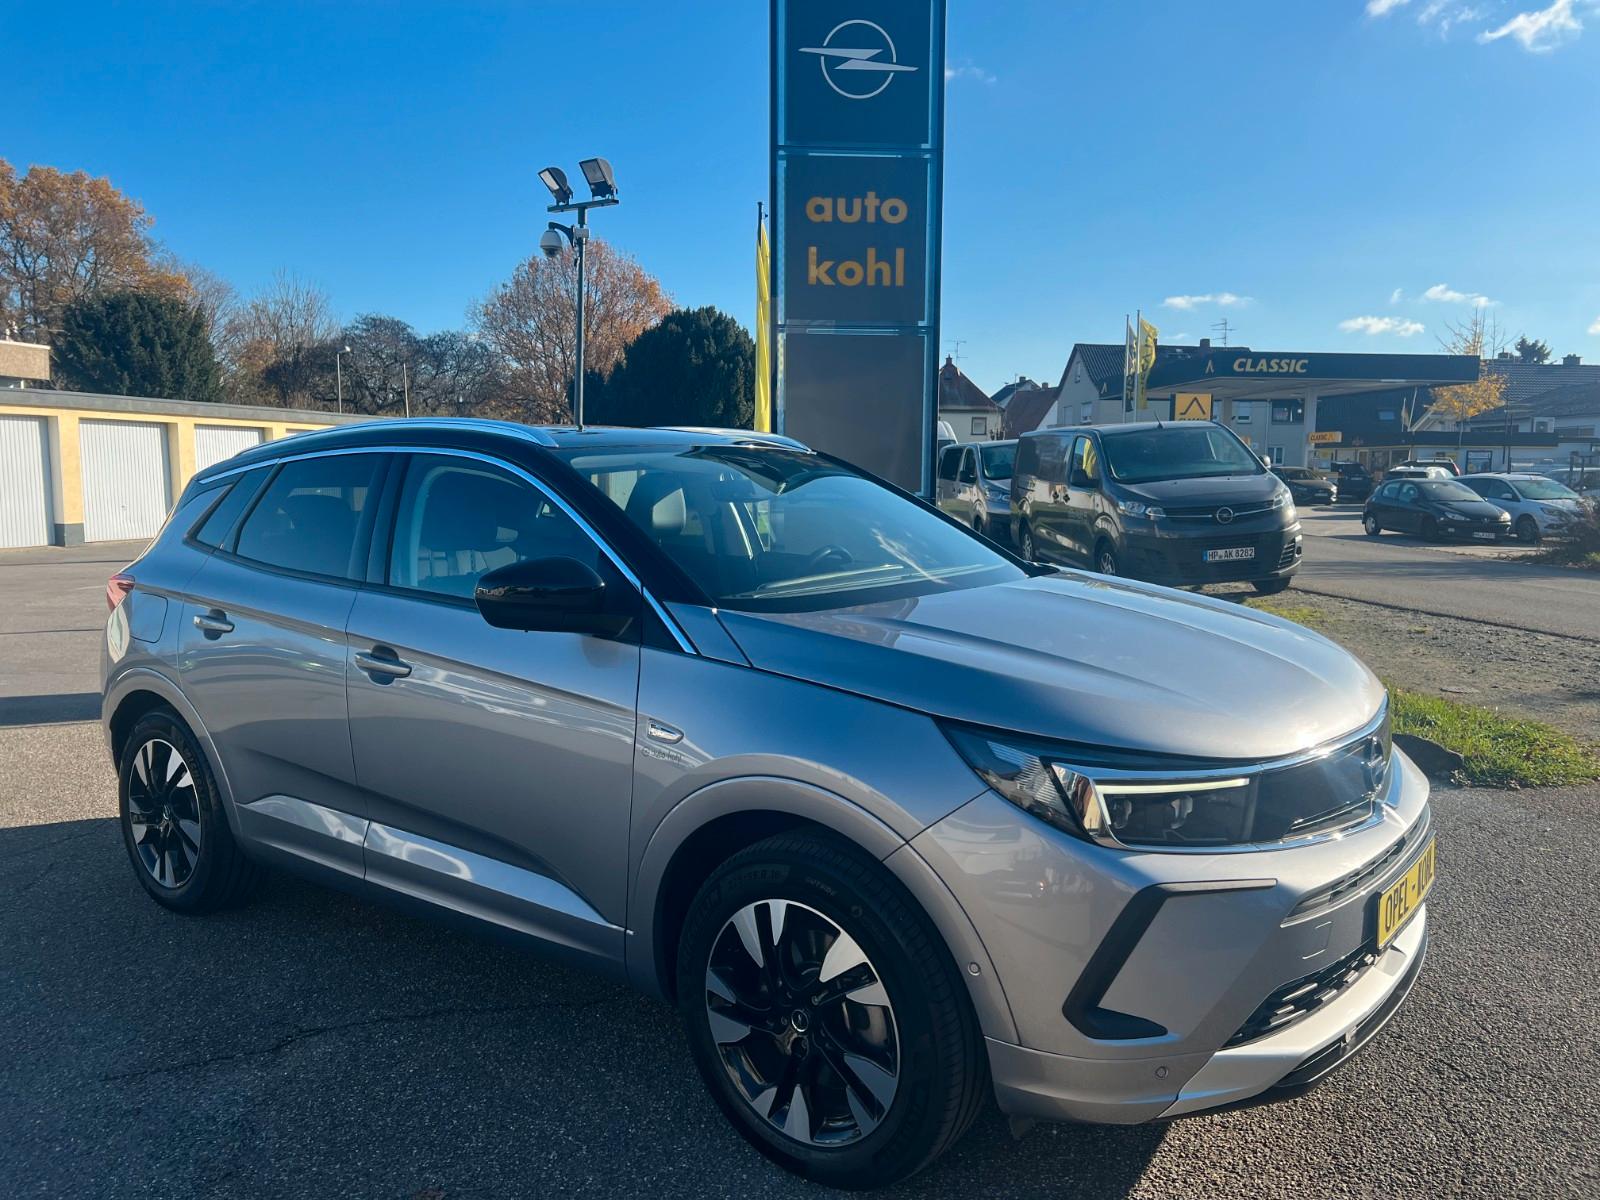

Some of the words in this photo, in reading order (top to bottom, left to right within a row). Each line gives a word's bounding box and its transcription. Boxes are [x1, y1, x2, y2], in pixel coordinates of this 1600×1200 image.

[806, 191, 908, 225] auto
[807, 246, 905, 287] kohl
[1233, 358, 1309, 373] CLASSIC
[1208, 551, 1218, 560] HP
[1223, 550, 1234, 560] AK
